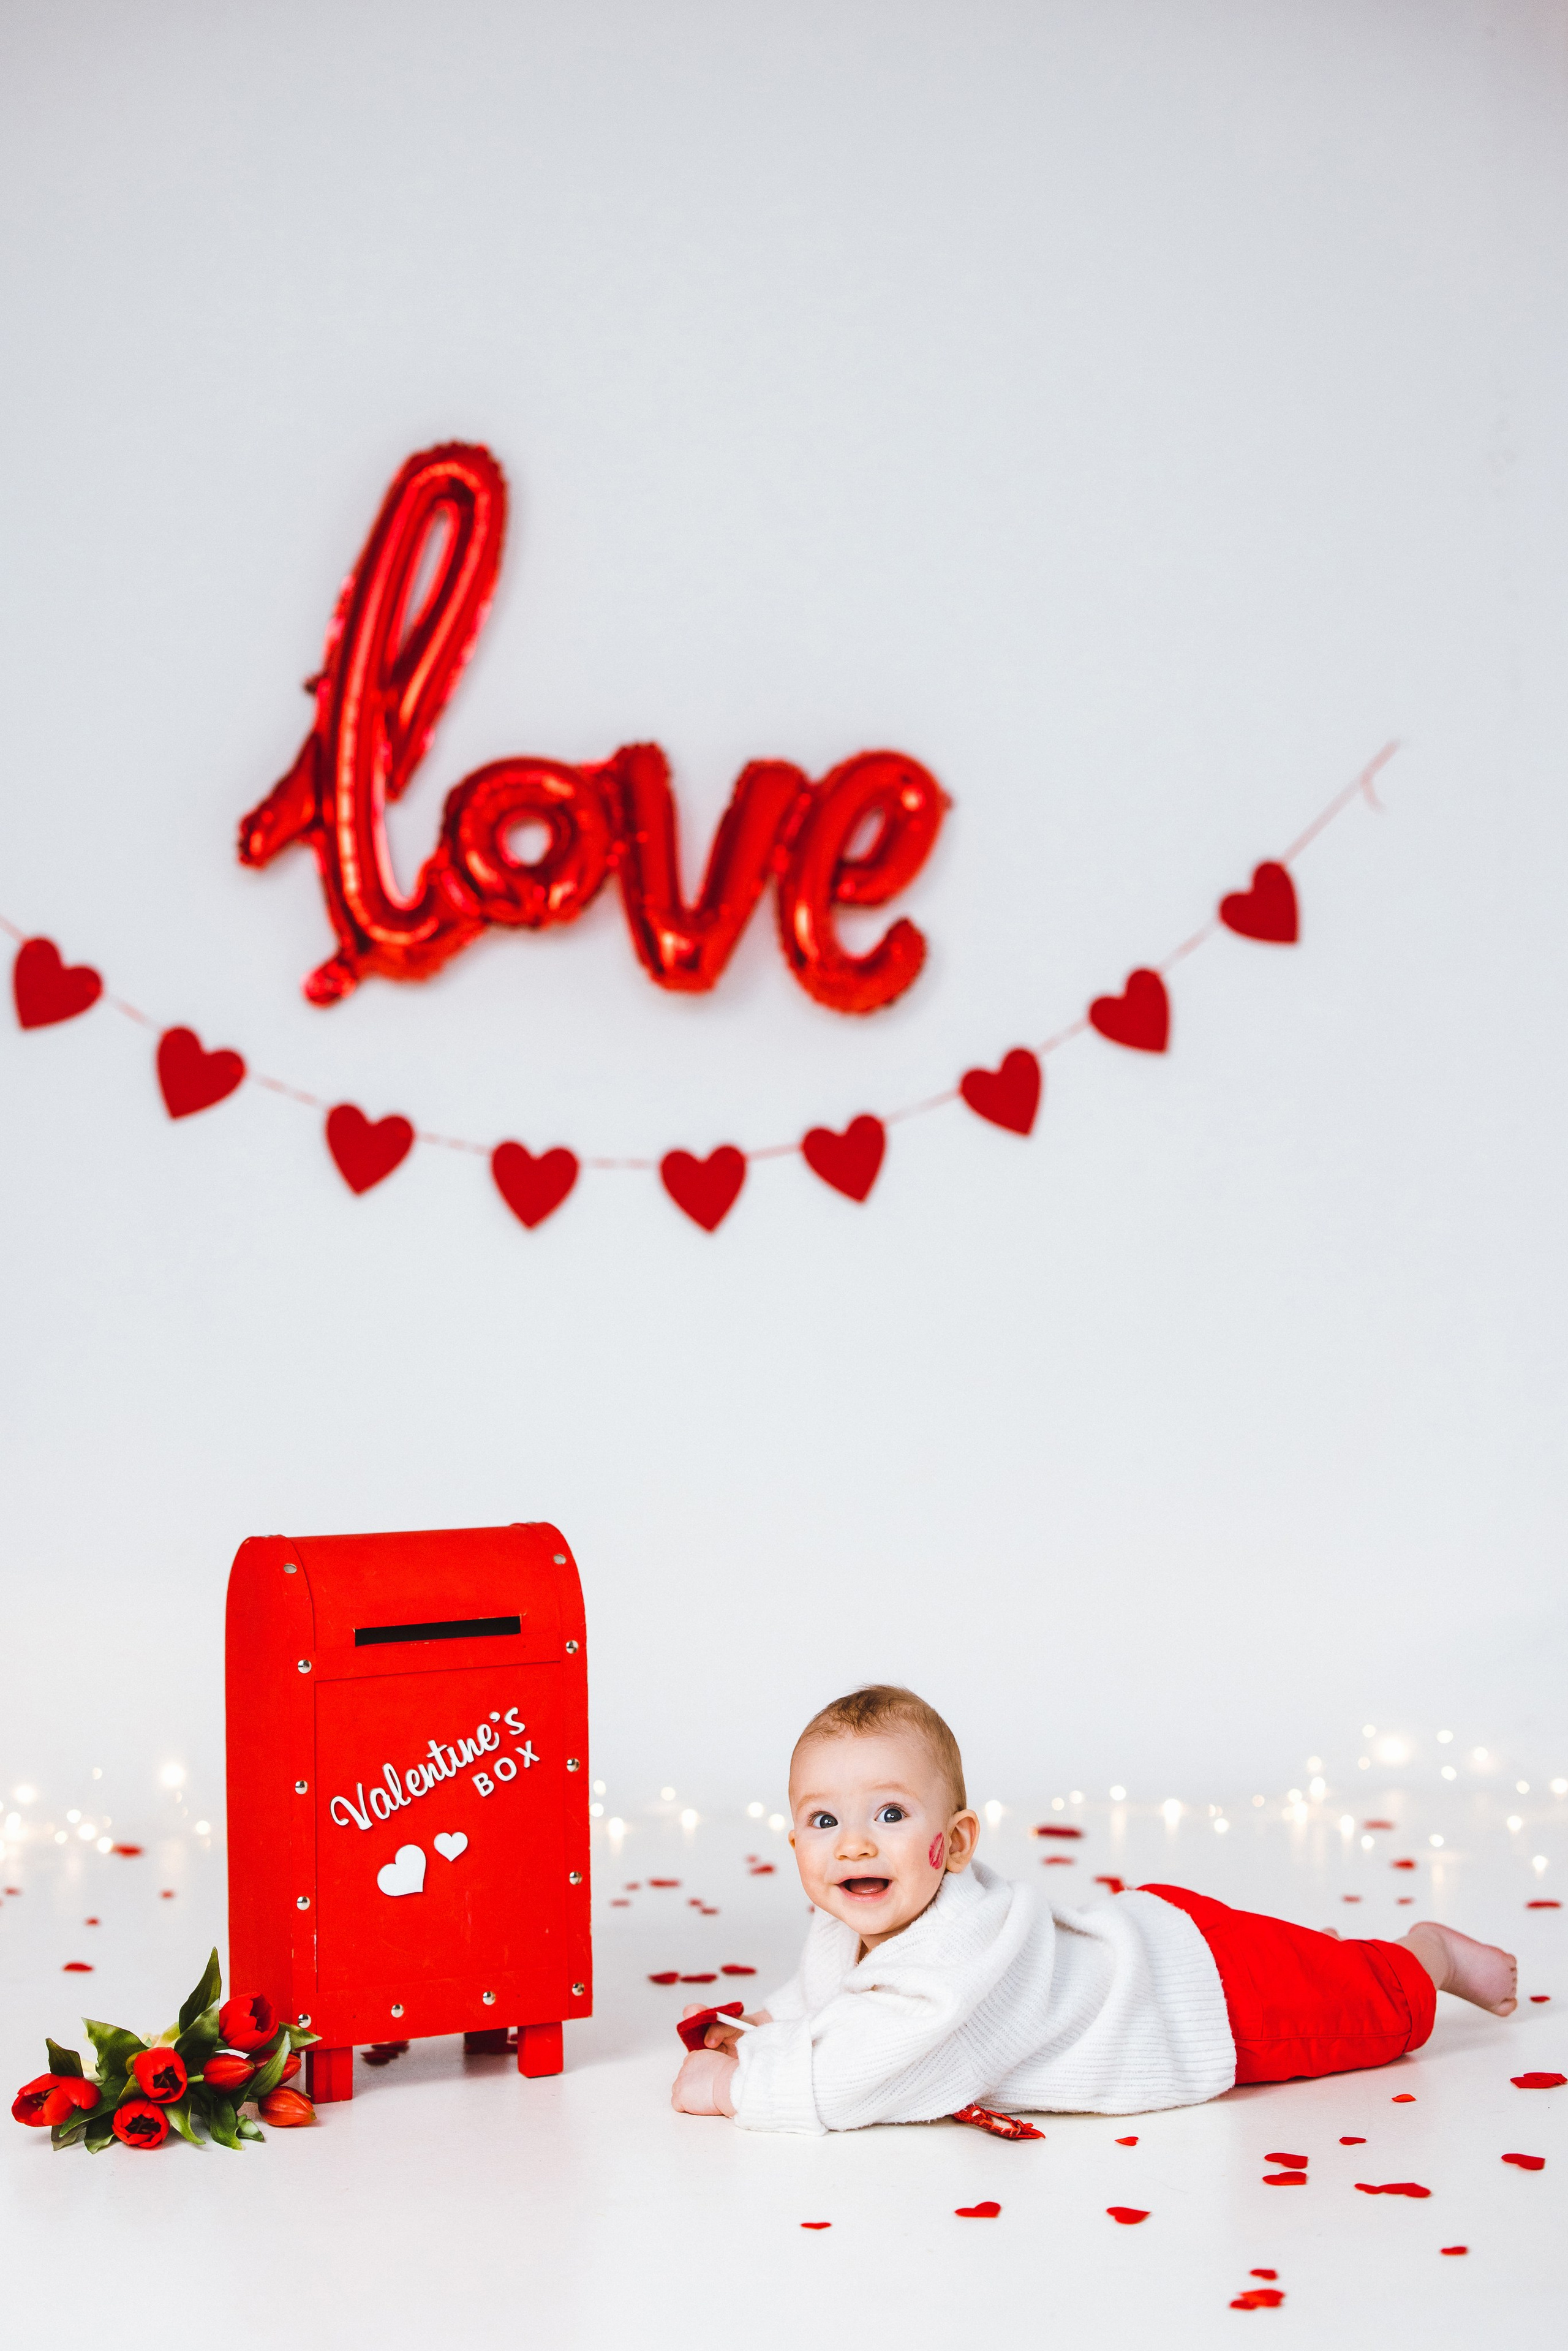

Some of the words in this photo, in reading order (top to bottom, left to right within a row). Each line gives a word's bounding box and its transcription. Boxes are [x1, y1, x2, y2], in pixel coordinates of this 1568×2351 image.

[238, 441, 951, 1016] love
[330, 1707, 526, 1830] Valentine's
[472, 1740, 540, 1797] BOX
